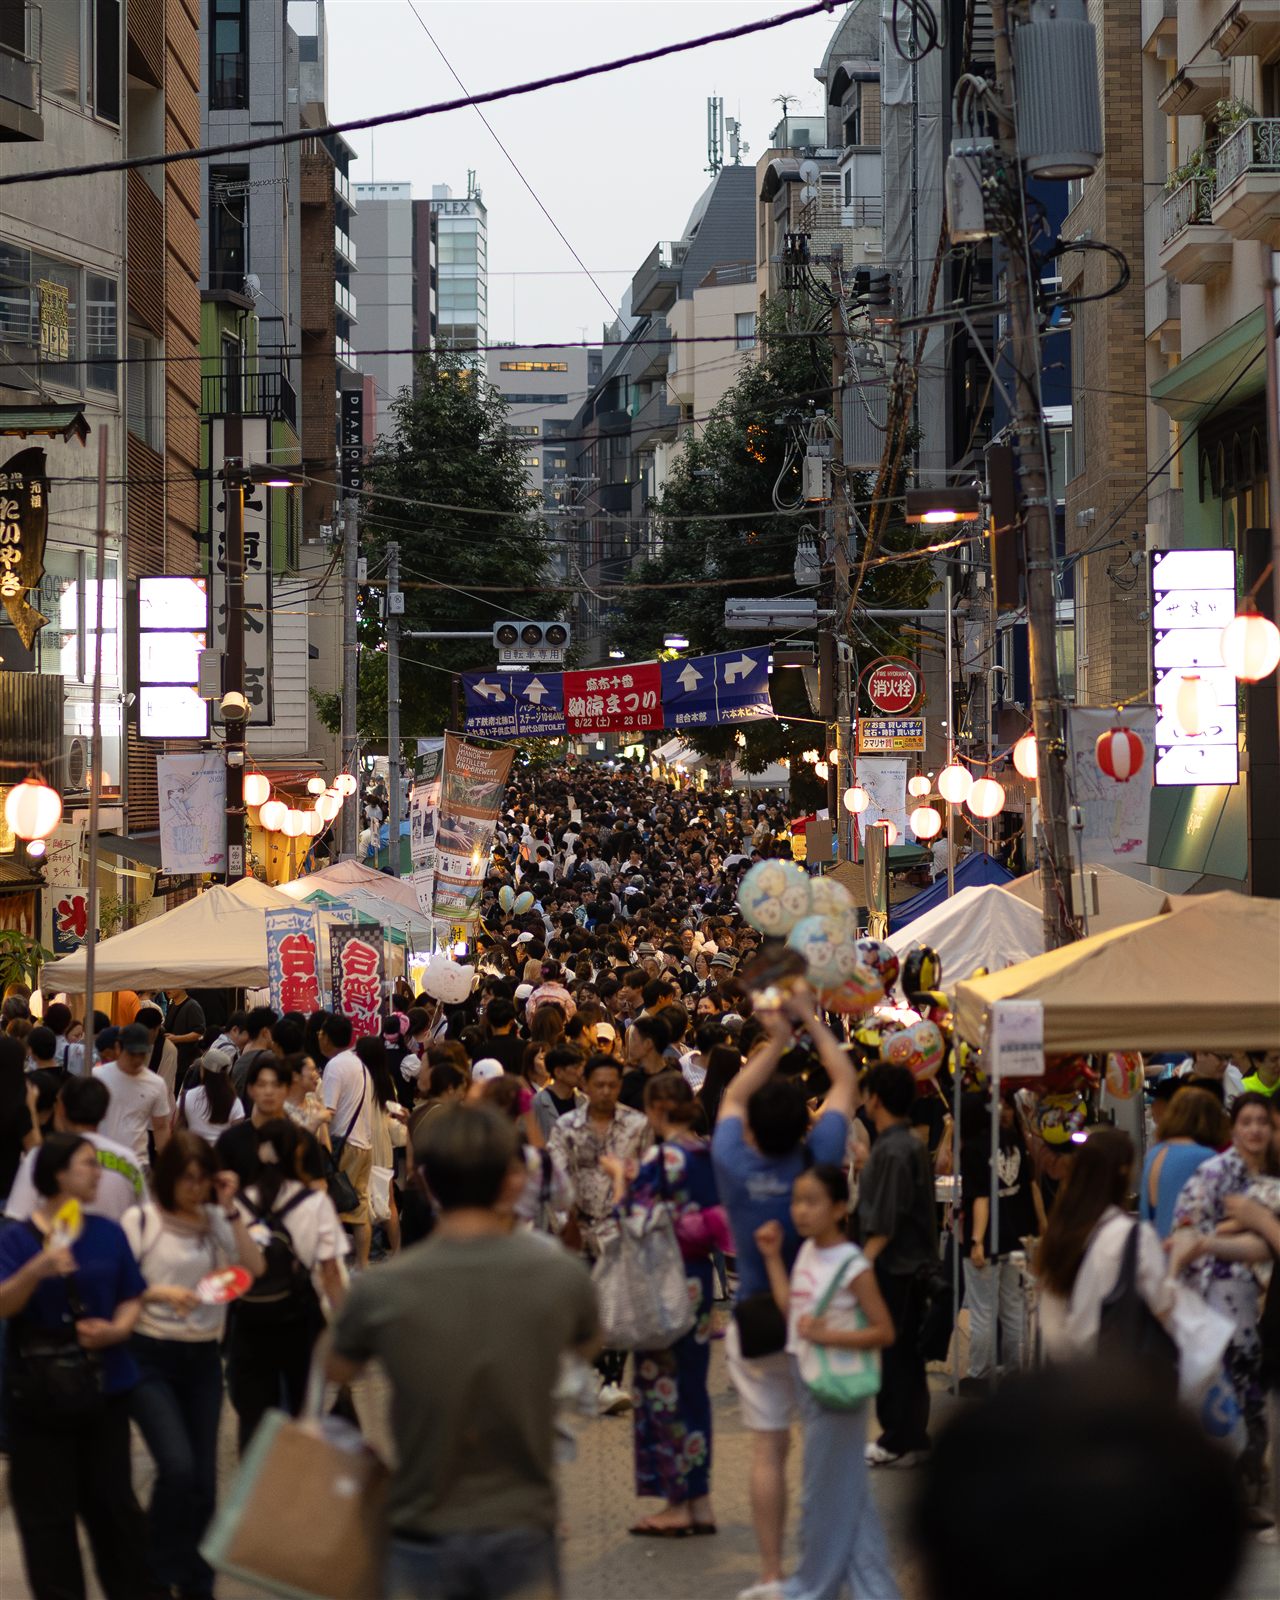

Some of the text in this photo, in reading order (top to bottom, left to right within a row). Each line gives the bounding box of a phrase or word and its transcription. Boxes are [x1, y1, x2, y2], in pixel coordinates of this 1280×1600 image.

[350, 396, 359, 487] DIAMOND
[0, 497, 21, 597] たいやき
[503, 649, 559, 659] 自転車専用
[586, 674, 634, 692] 麻布十番
[873, 679, 912, 697] 消火栓
[567, 690, 657, 717] 納涼まつり
[675, 711, 707, 724] 組合本部
[456, 756, 488, 768] DISTILLERY
[460, 749, 481, 760] MANOR
